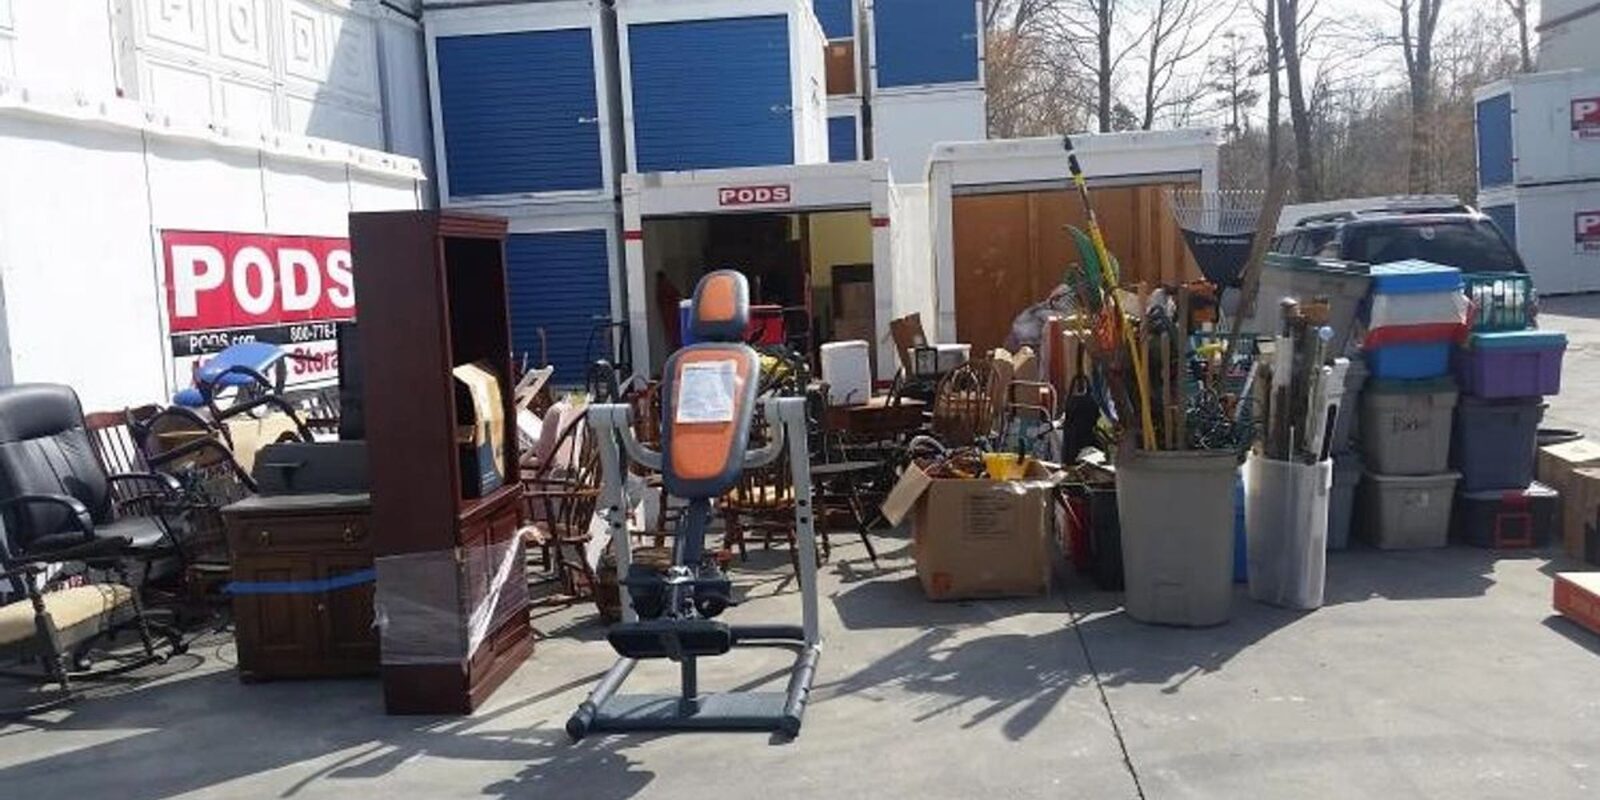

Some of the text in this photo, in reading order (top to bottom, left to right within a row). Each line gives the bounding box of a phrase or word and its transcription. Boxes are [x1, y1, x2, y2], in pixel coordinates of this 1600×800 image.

[720, 187, 788, 203] PODS
[171, 245, 355, 317] PODS
[189, 332, 257, 353] PODScom
